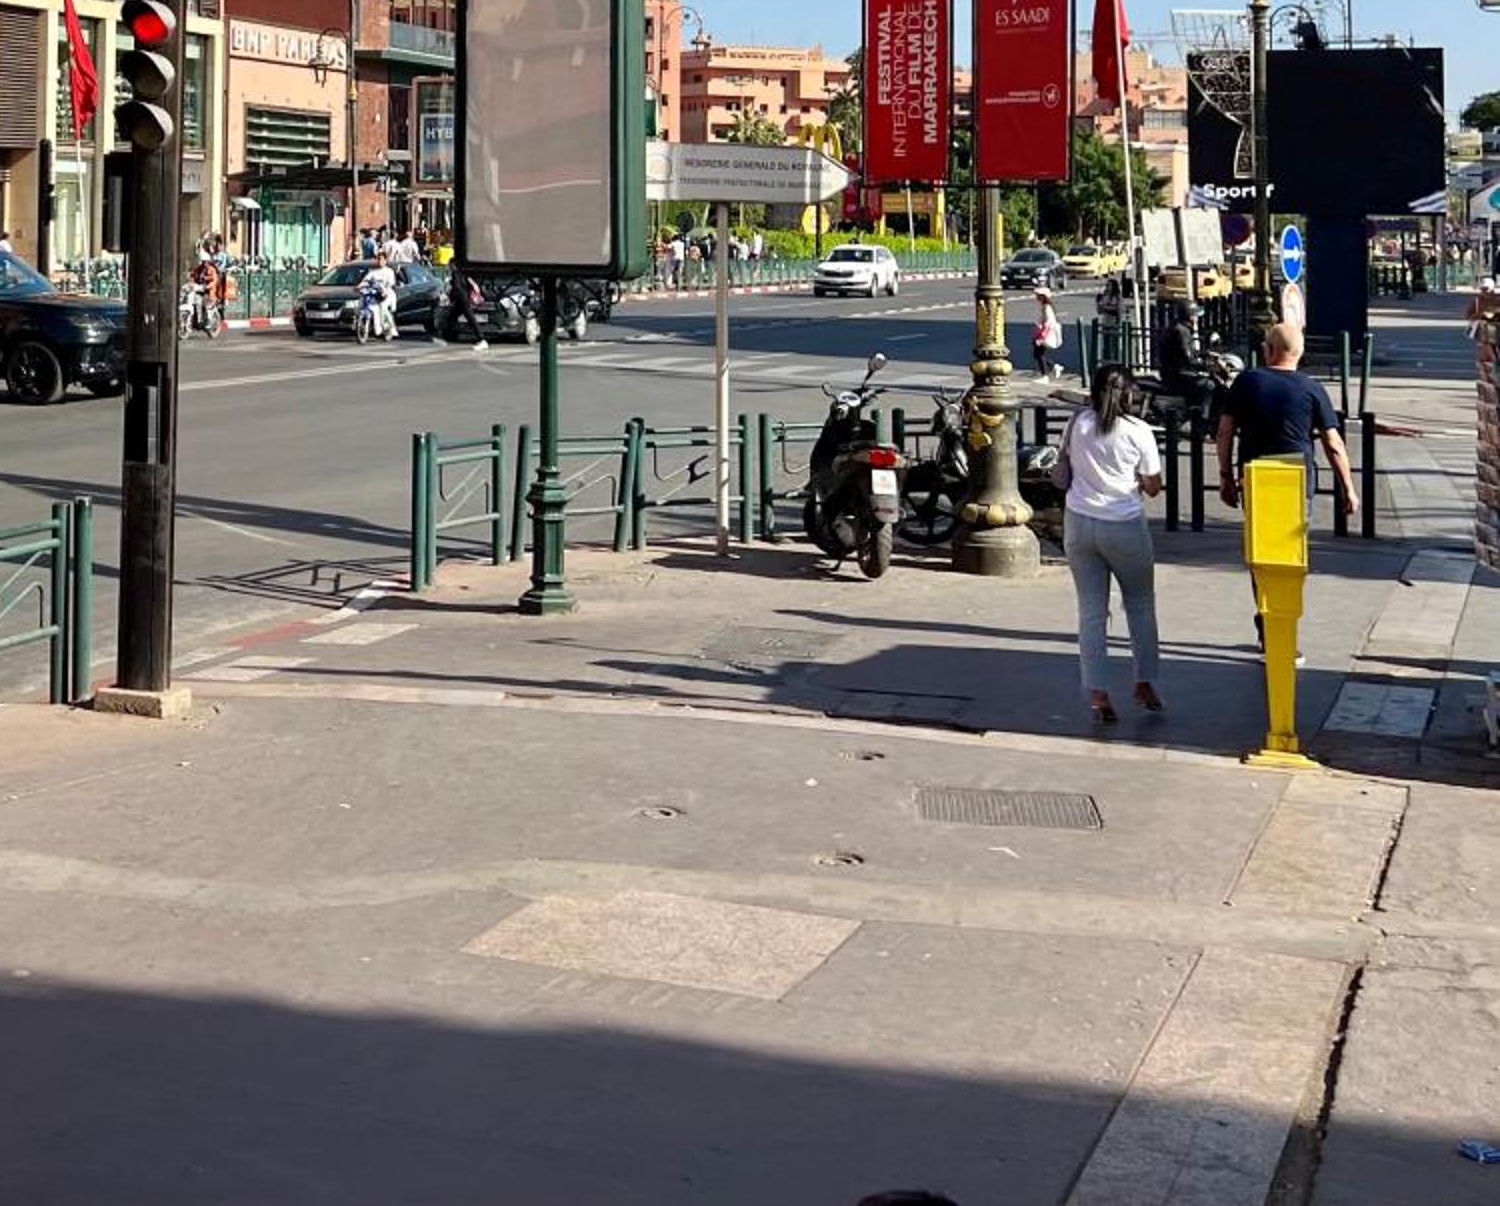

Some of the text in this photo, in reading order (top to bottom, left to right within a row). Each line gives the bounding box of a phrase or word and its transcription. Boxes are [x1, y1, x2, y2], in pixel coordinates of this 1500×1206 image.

[877, 4, 891, 105] FESTIVAL
[907, 1, 922, 119] DU FILM DE
[995, 7, 1050, 26] ES SAADI
[892, 2, 907, 157] INTERNATIONAL
[425, 126, 454, 139] HYB
